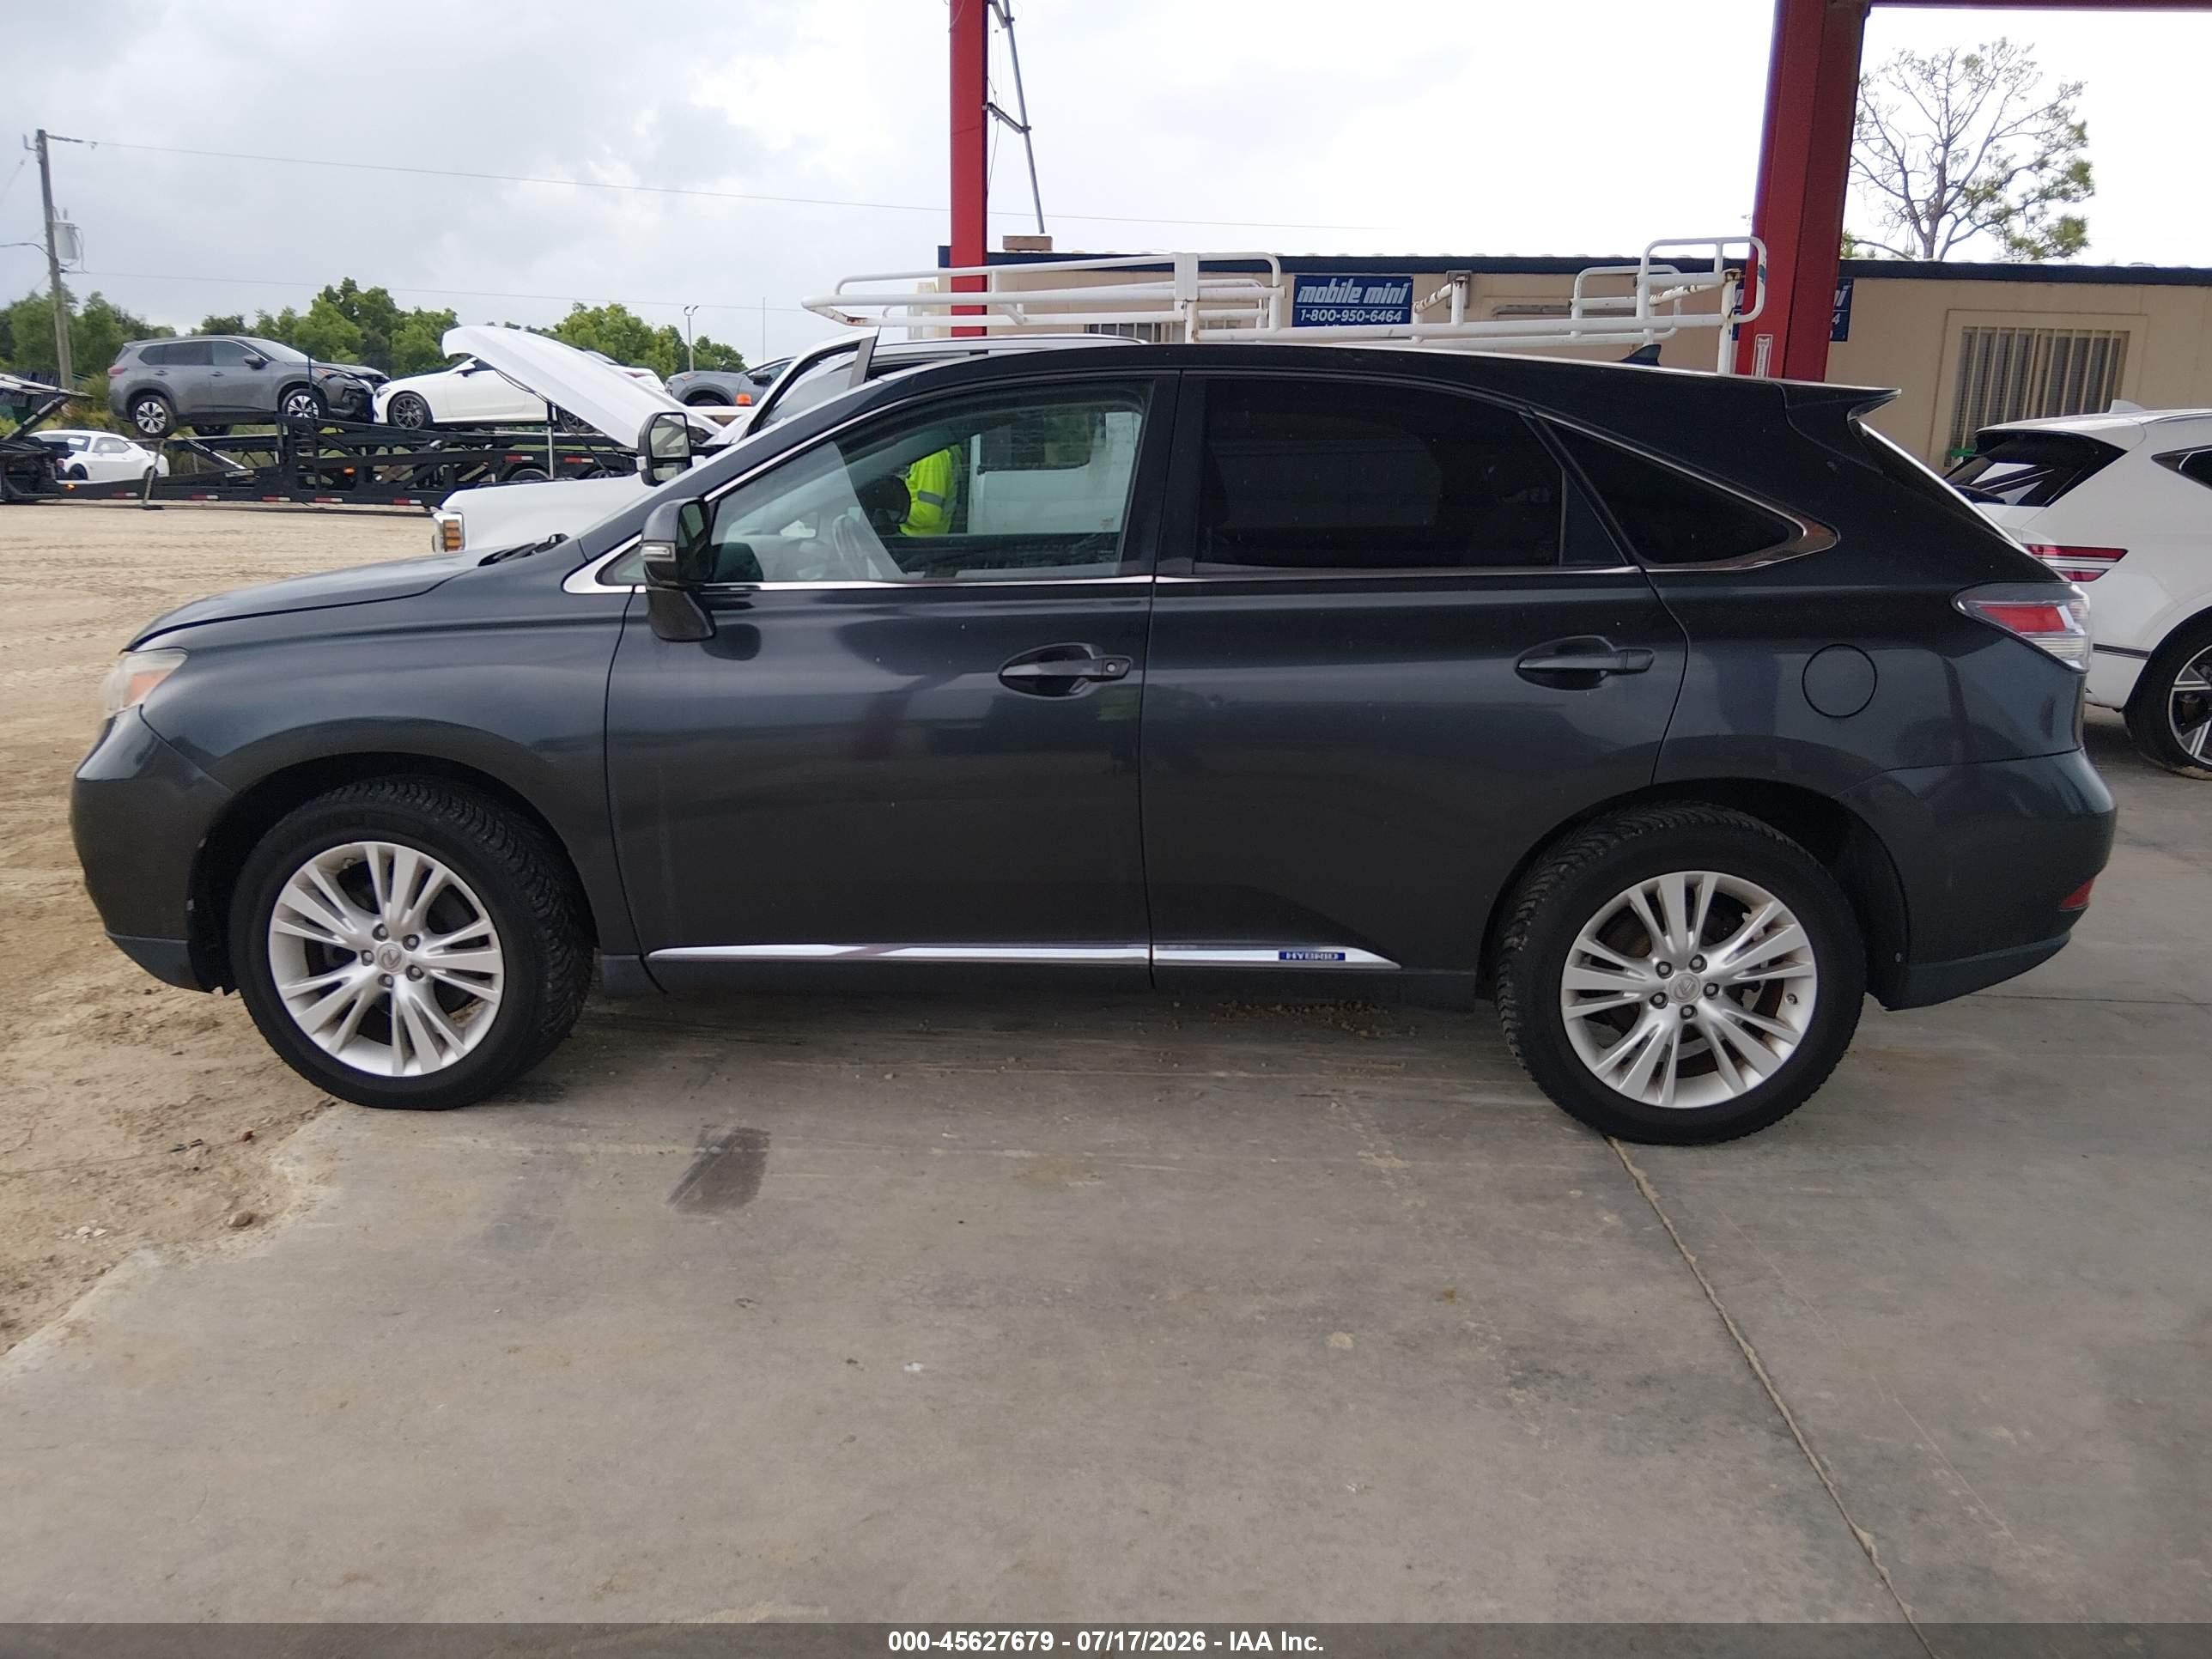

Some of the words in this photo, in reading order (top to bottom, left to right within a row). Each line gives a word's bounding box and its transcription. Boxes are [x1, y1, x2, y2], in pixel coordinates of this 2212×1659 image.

[1297, 277, 1363, 304] mobile
[1363, 282, 1410, 305] mini
[1300, 309, 1402, 323] 1-800-950-6464
[1285, 951, 1340, 960] HYBRID
